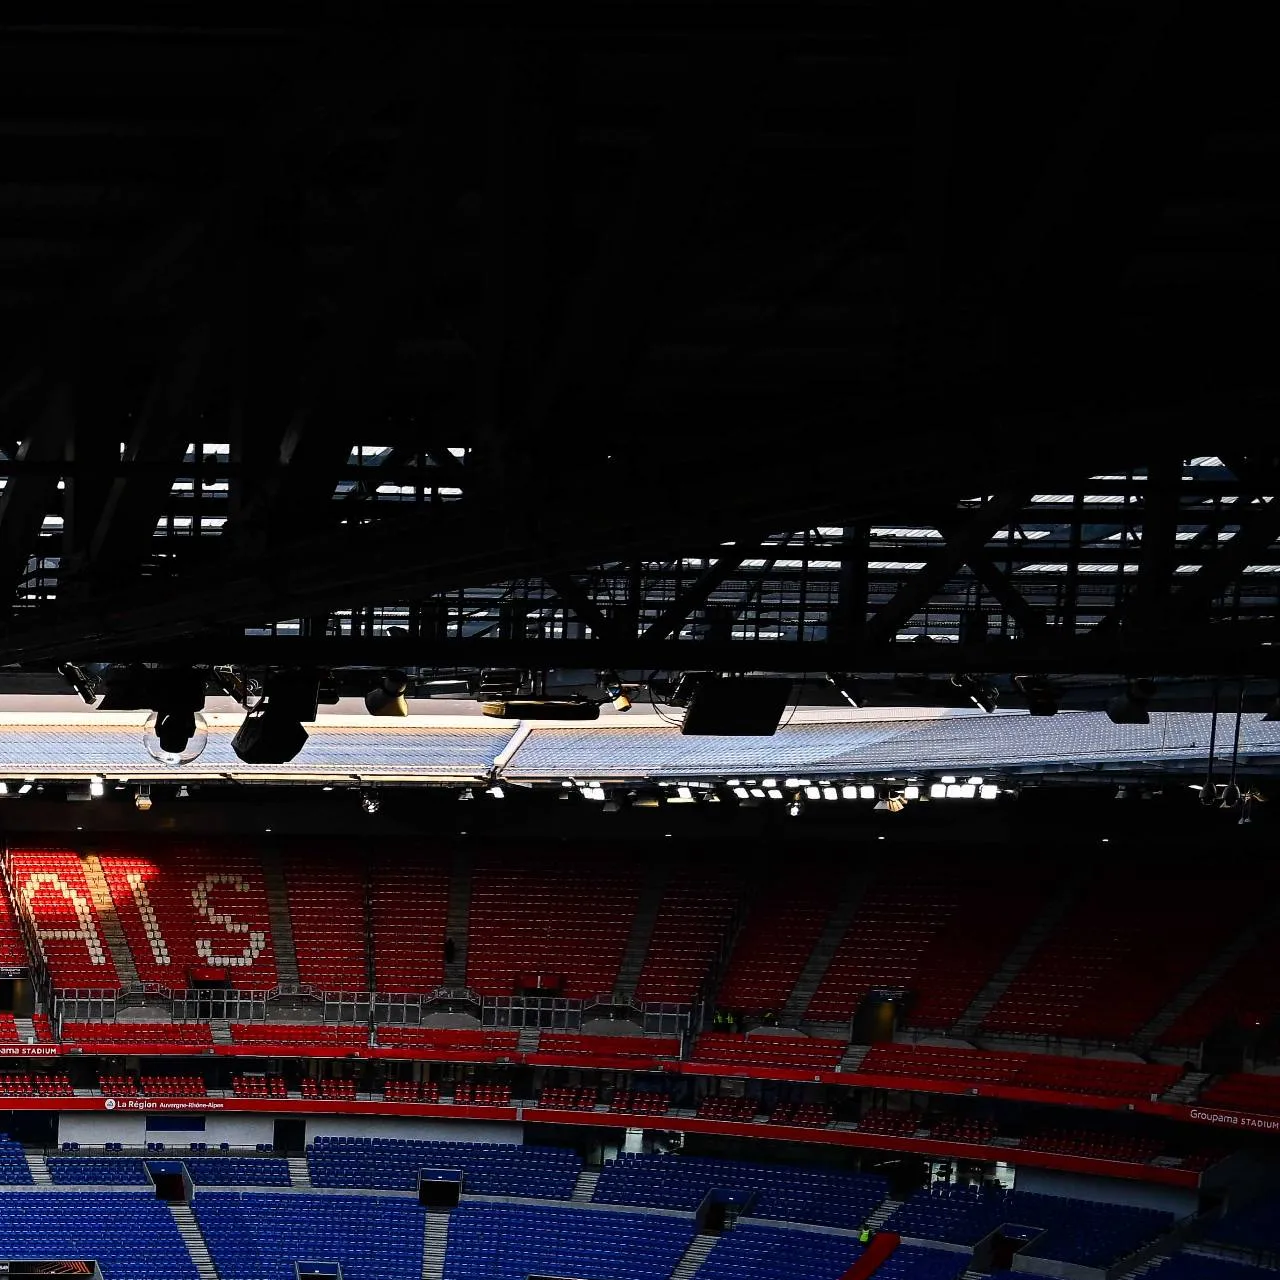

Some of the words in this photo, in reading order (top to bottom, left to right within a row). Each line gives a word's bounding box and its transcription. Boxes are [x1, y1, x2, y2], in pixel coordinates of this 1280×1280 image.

[21, 1047, 57, 1056] STADIUM
[117, 1100, 127, 1108] La
[128, 1099, 157, 1111] Région
[1190, 1109, 1238, 1124] Groupama
[1240, 1117, 1280, 1129] STADIUM
